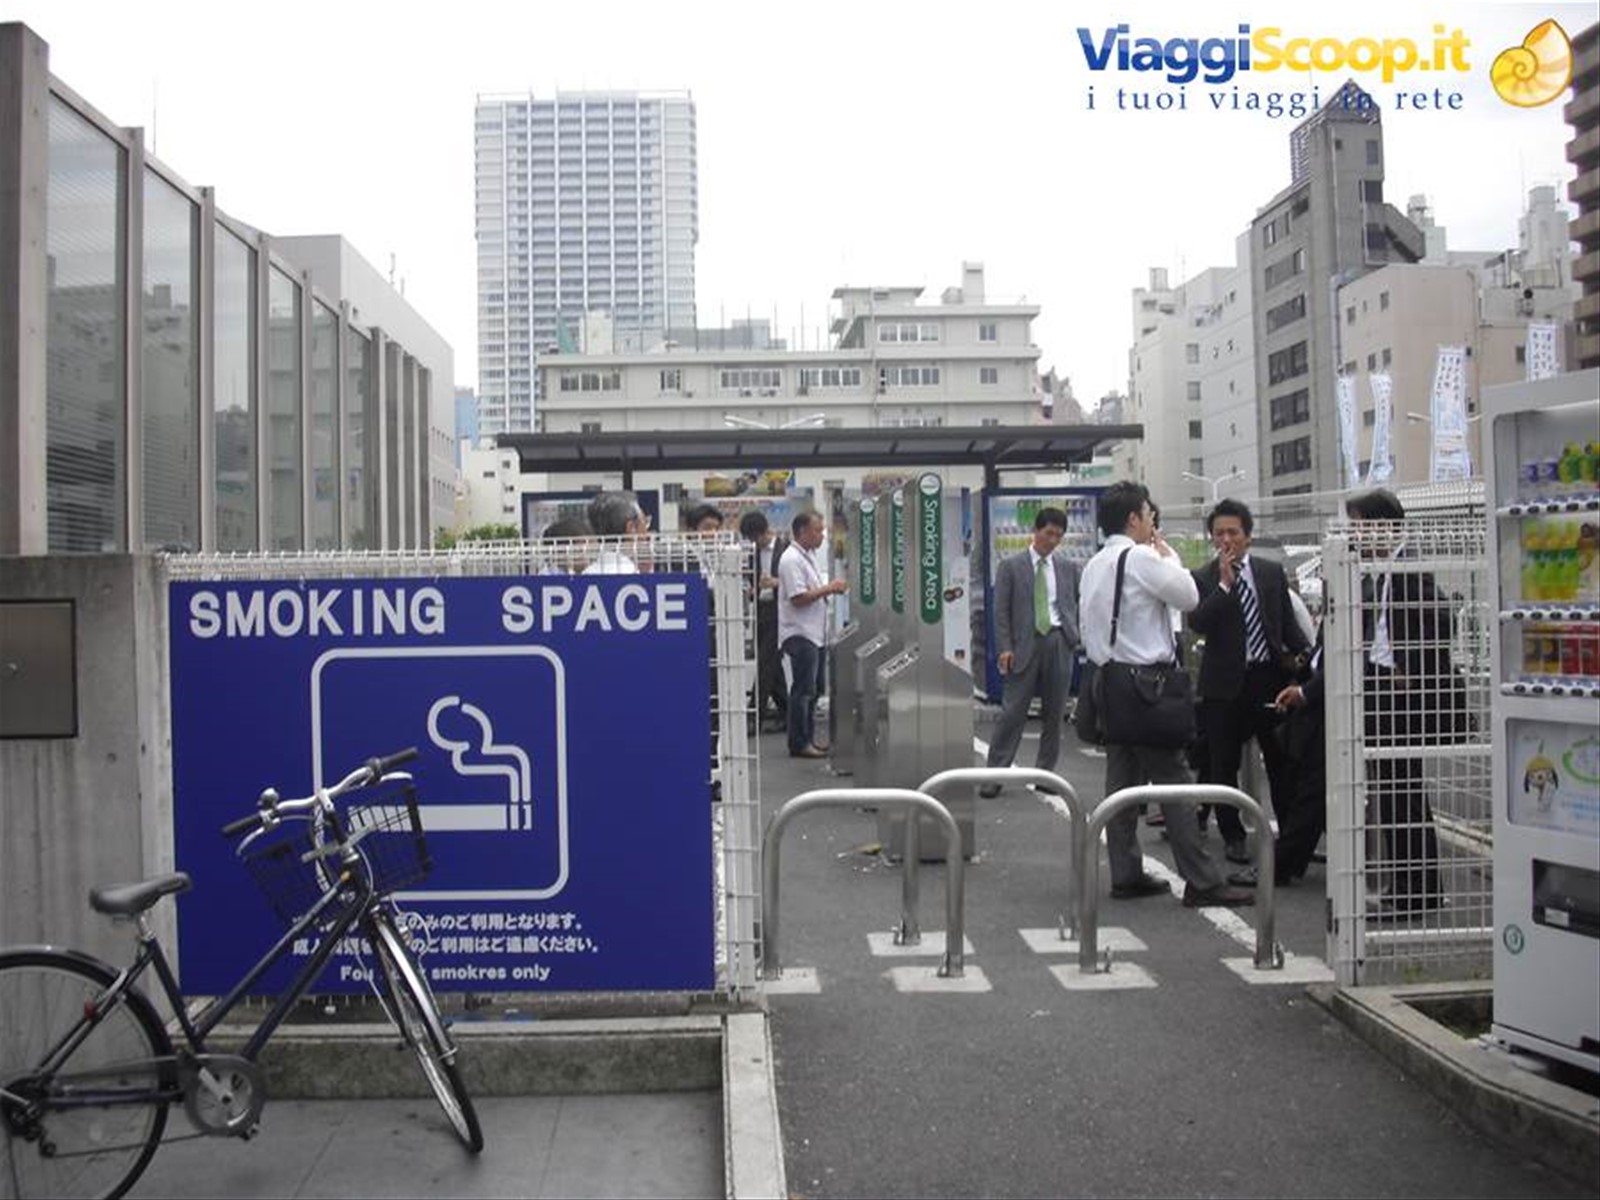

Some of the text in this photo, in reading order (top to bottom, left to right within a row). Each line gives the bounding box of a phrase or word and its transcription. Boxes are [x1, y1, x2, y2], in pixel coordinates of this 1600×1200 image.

[922, 499, 938, 610] Smoking Area
[189, 583, 689, 639] SMOKING SPACE
[431, 963, 507, 980] smokres
[512, 963, 551, 982] only
